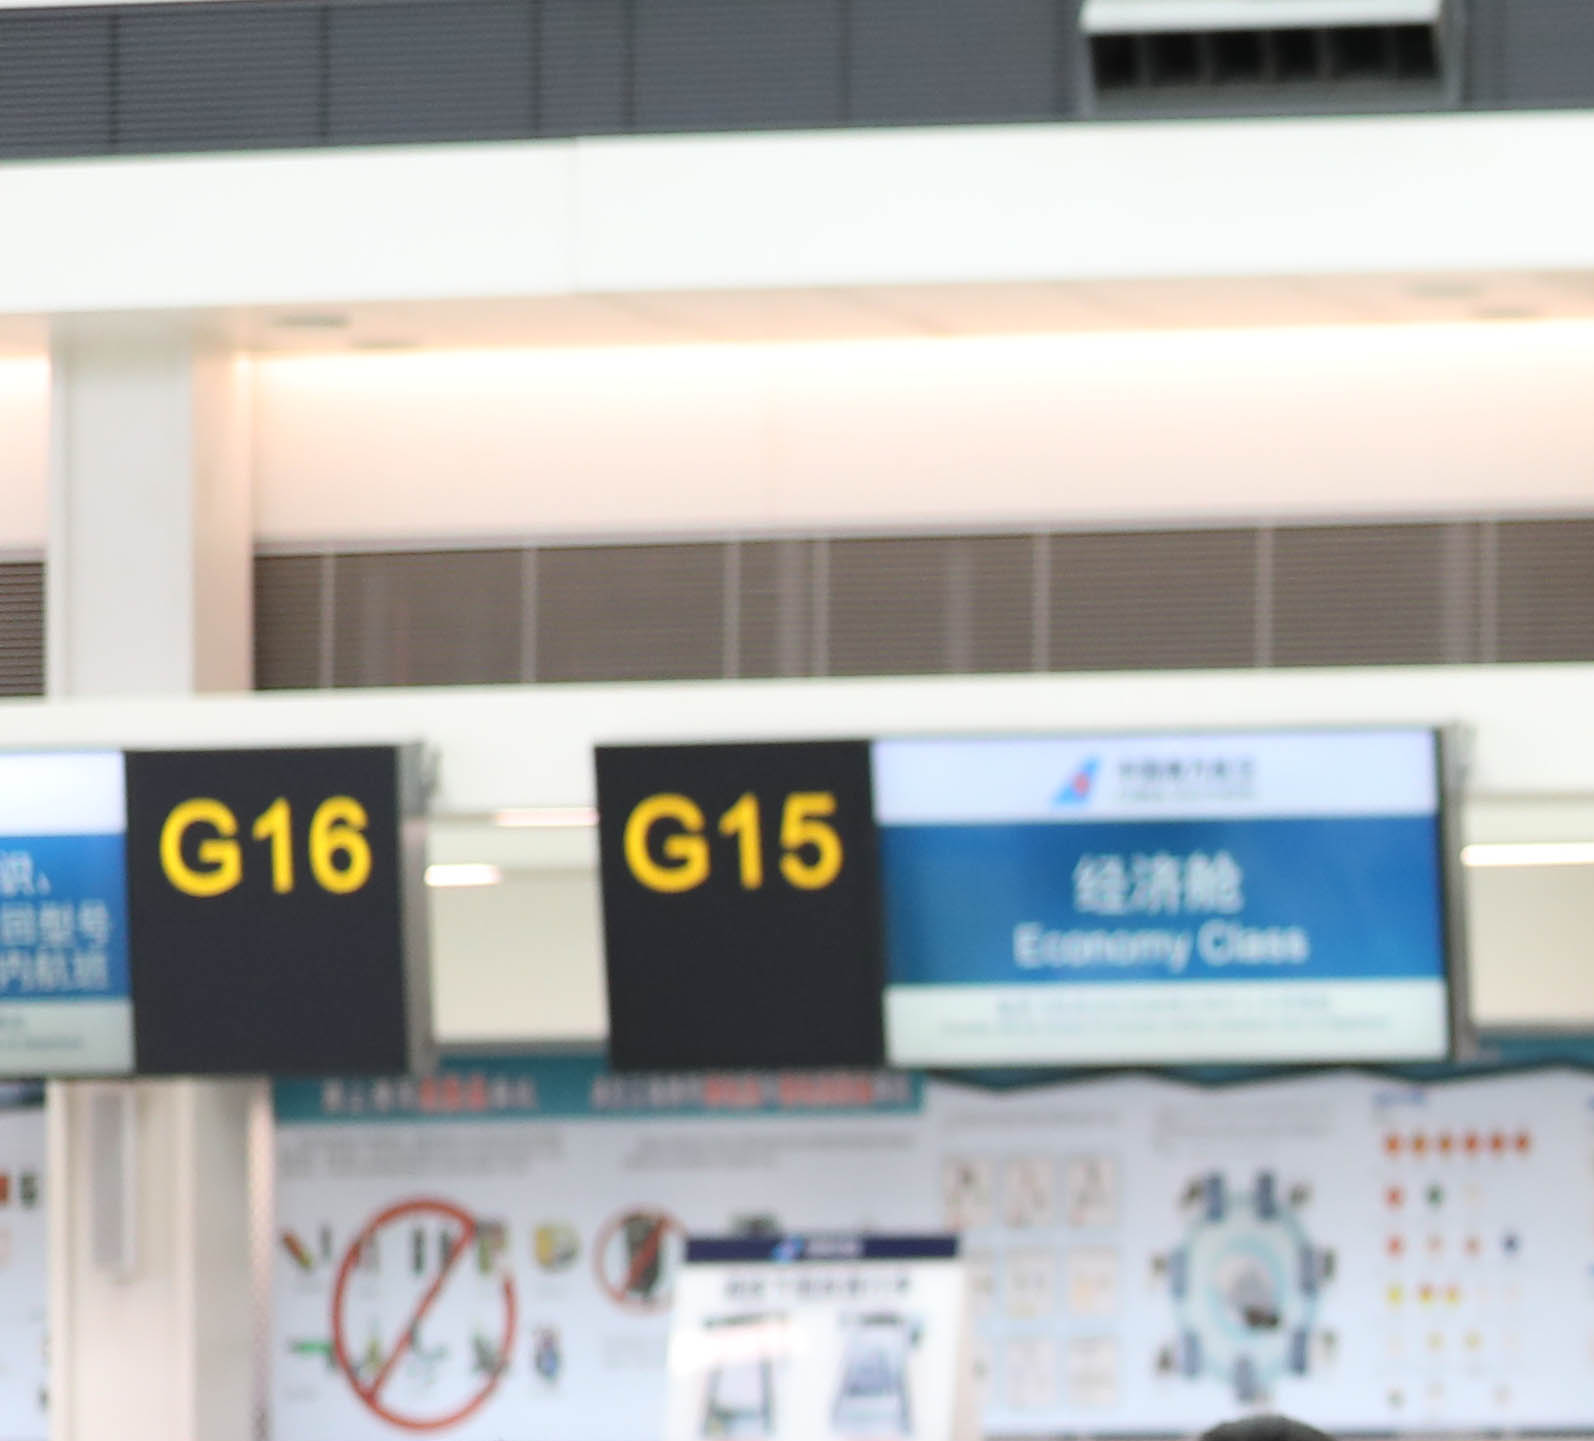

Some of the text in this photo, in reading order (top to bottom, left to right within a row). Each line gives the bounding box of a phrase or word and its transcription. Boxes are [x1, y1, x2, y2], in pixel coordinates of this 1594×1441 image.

[160, 796, 372, 896] G16
[624, 792, 843, 893] G15
[1073, 851, 1244, 916] 经济舱
[1013, 917, 1310, 973] Economy Class
